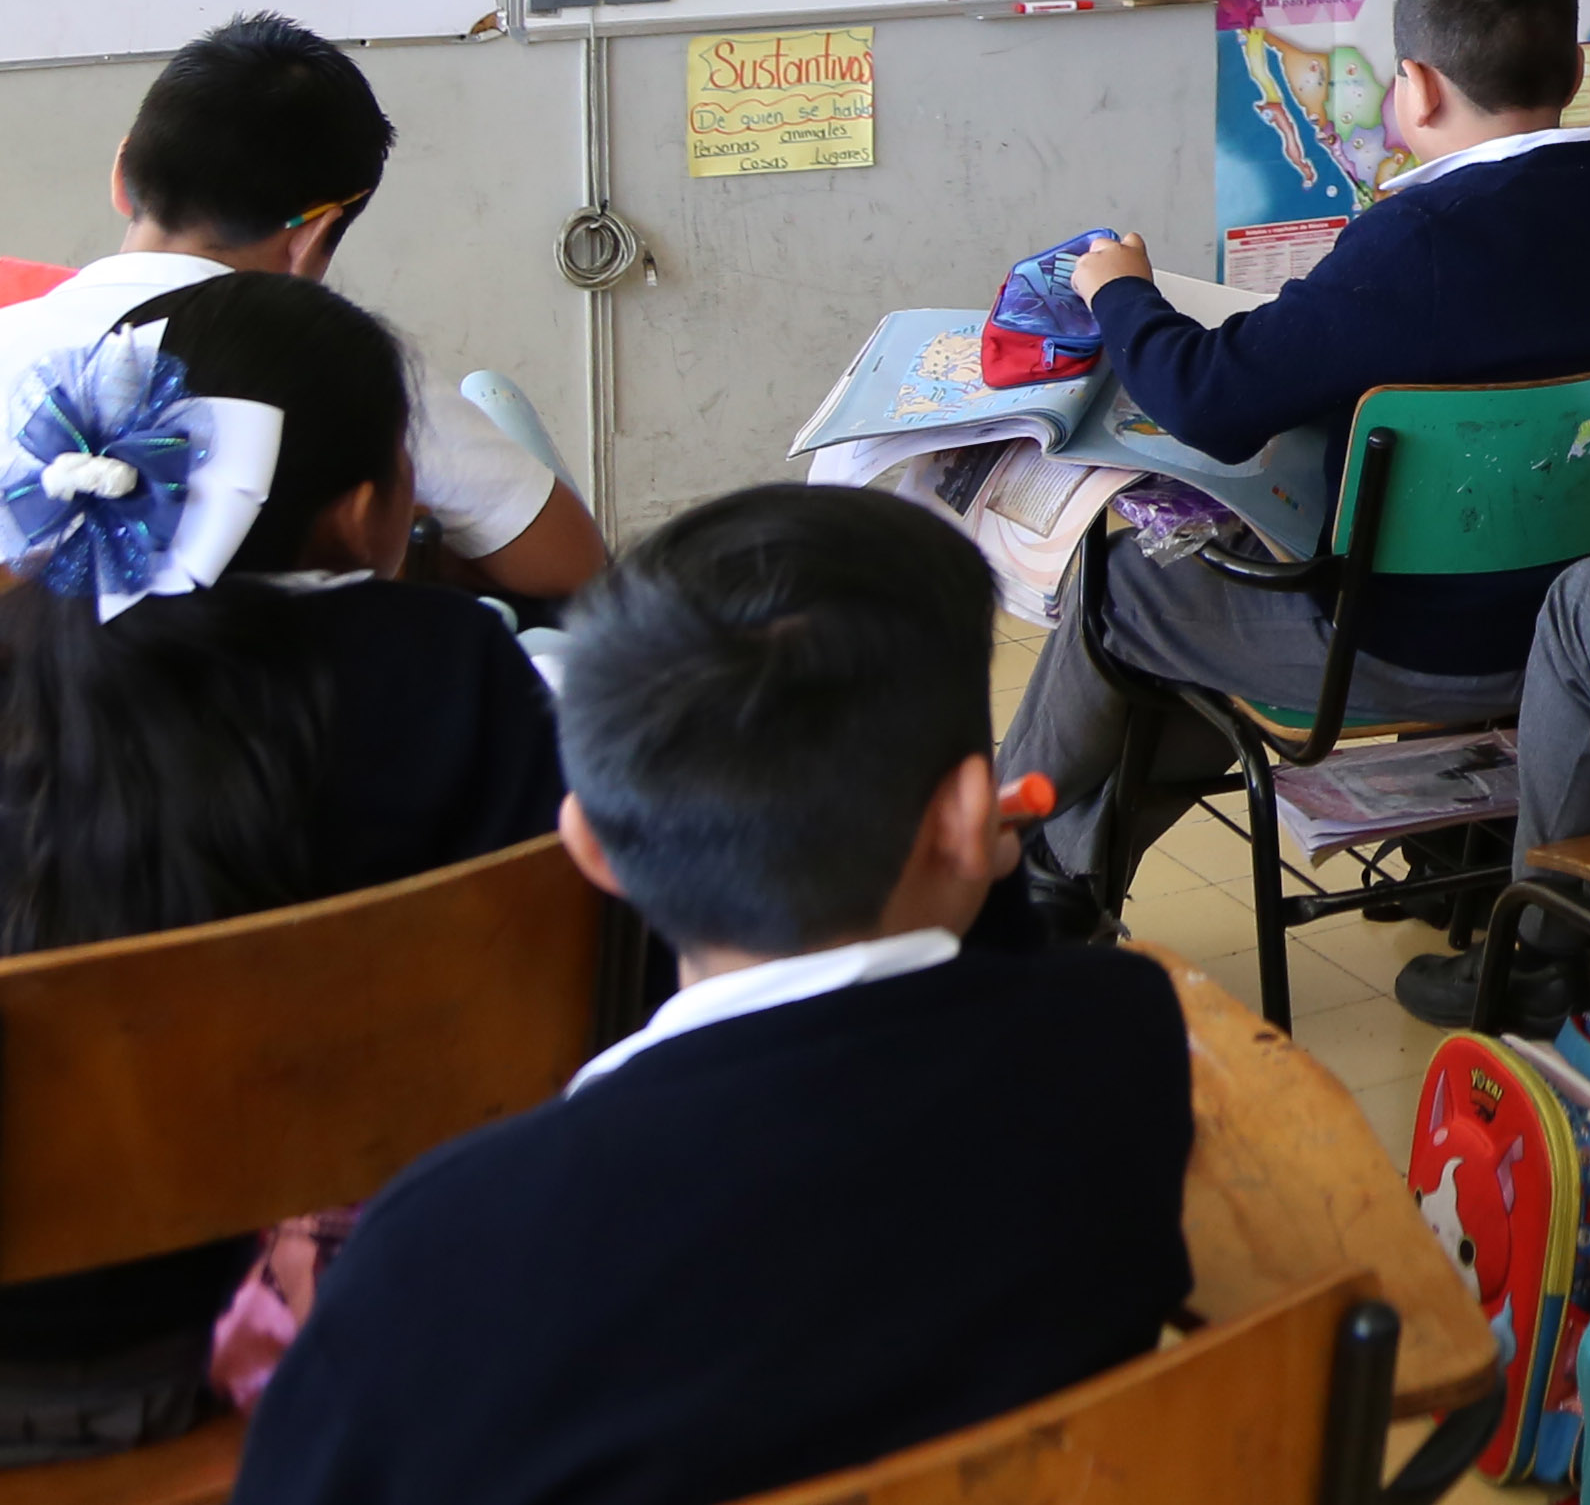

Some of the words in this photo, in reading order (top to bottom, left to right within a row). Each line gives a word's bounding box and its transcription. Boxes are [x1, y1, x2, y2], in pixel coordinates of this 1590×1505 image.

[708, 31, 875, 90] Sustantivos
[694, 108, 727, 131] De
[798, 103, 820, 119] se
